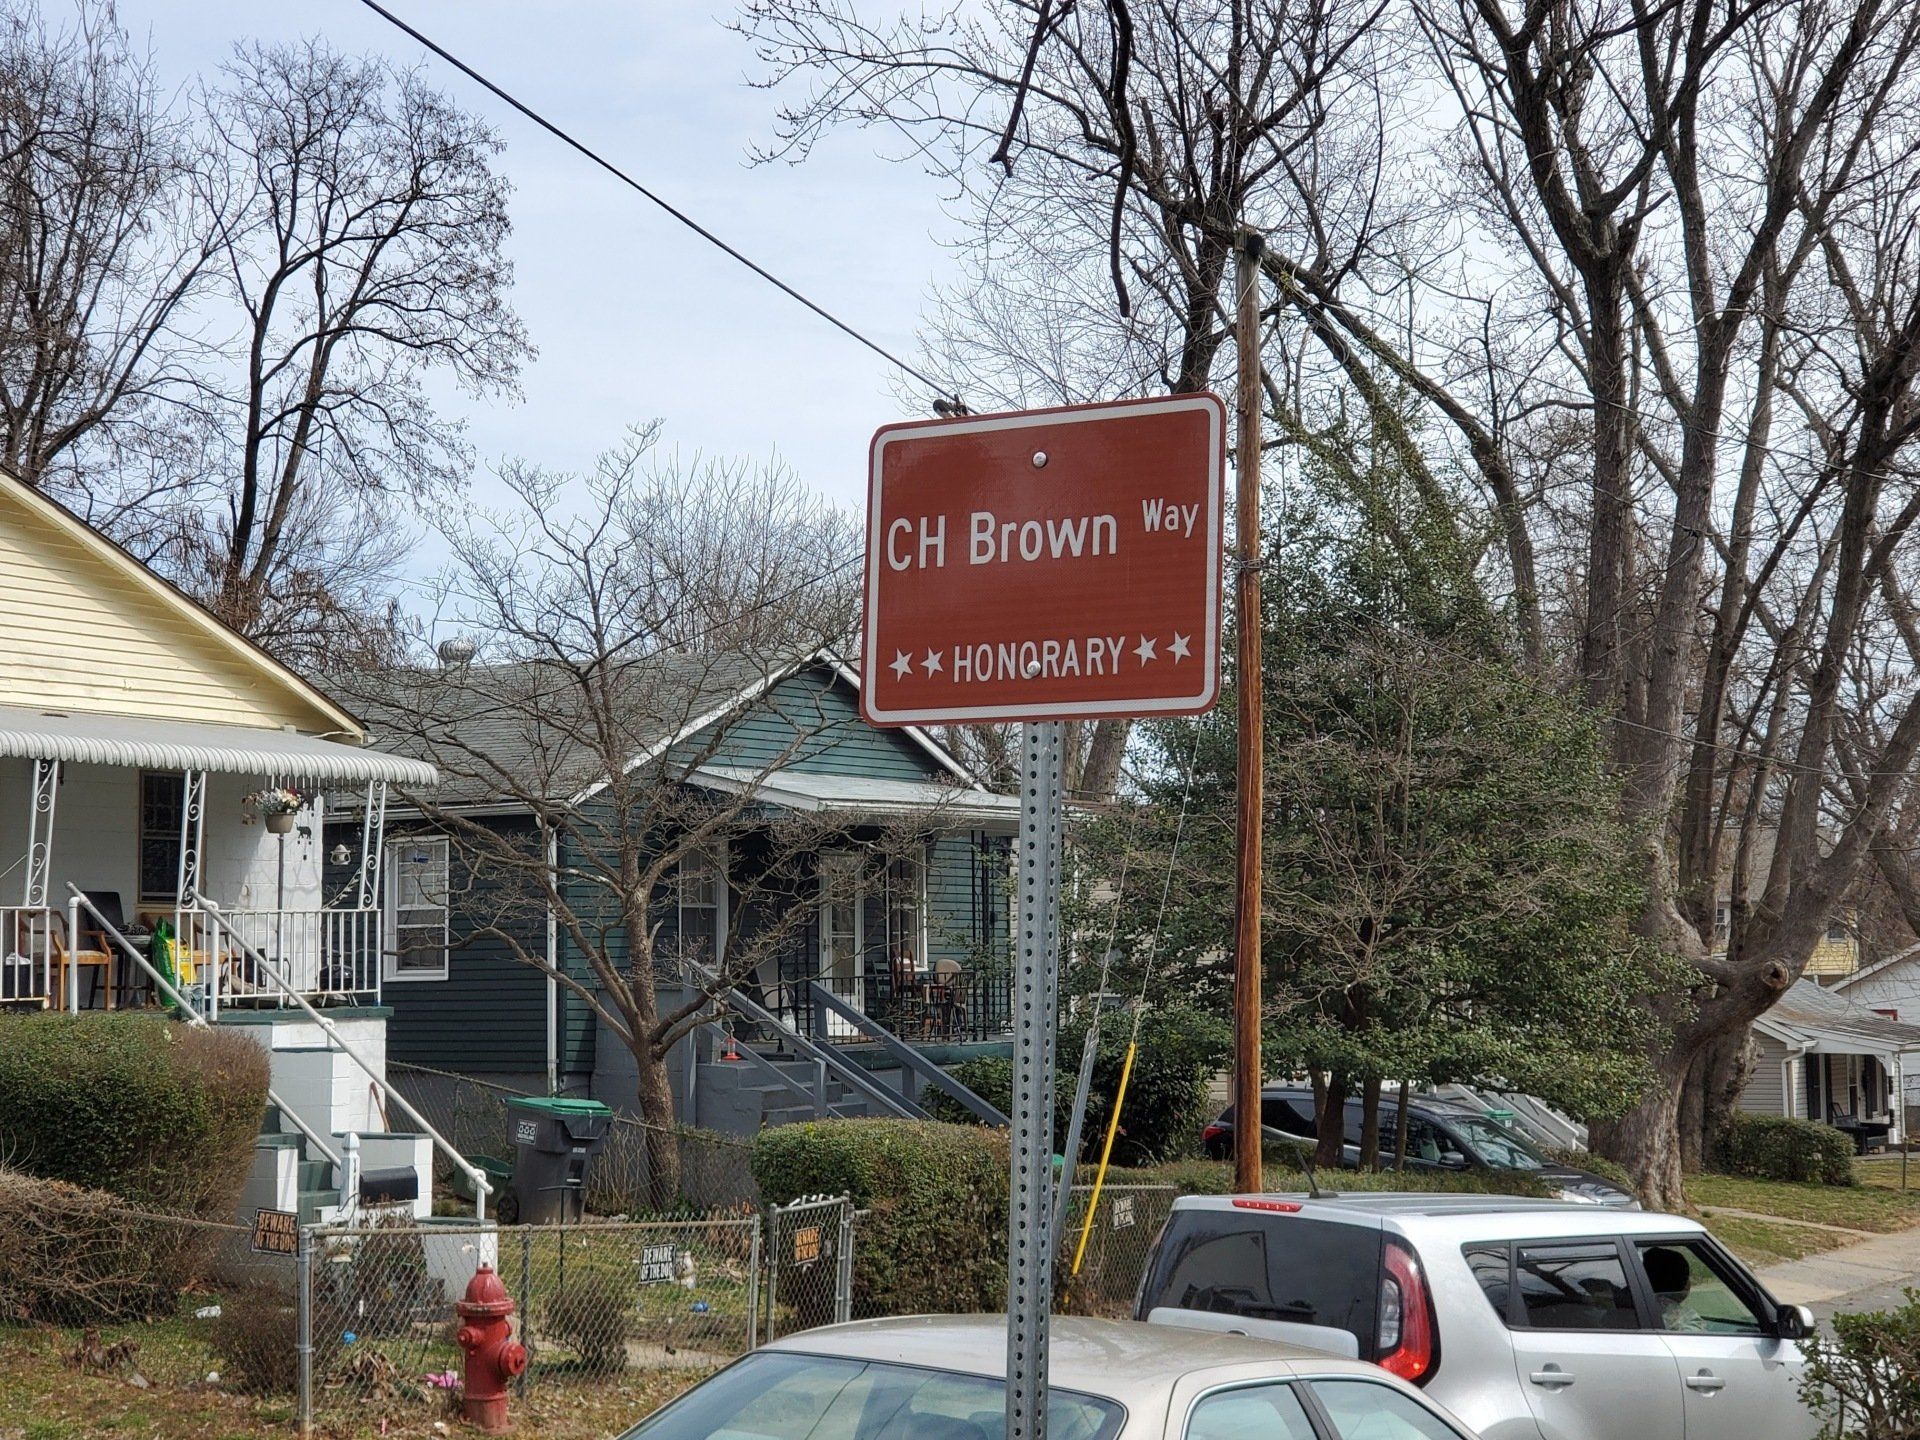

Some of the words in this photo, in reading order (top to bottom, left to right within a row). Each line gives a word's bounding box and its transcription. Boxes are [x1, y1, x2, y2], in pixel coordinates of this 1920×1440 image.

[887, 514, 946, 571] CH
[969, 511, 1117, 565] Brown
[1141, 497, 1200, 539] Way
[953, 635, 1126, 683] HONORARY
[258, 1213, 296, 1234] BEWARE
[255, 1231, 265, 1248] OF
[265, 1232, 280, 1250] THE
[279, 1233, 297, 1251] DOG
[642, 1246, 674, 1265] BEWARE
